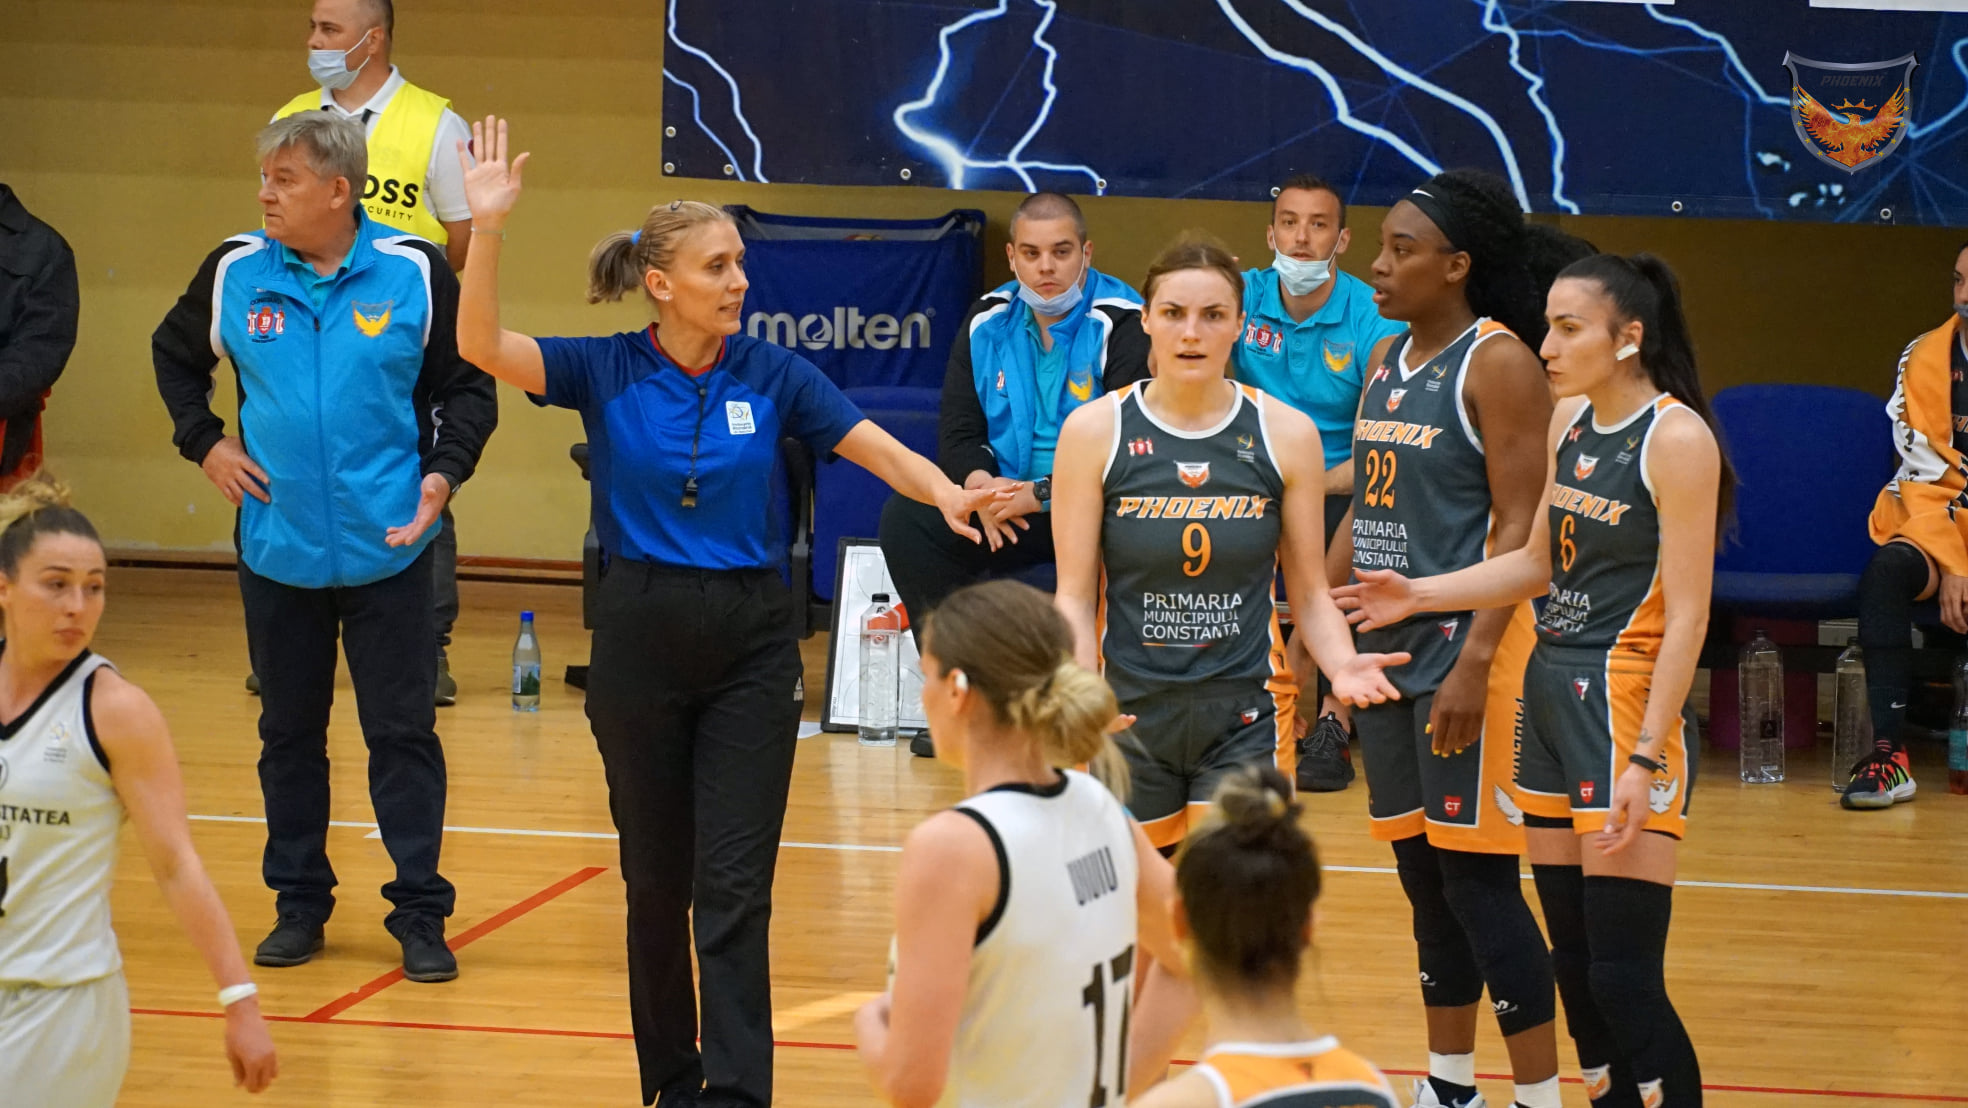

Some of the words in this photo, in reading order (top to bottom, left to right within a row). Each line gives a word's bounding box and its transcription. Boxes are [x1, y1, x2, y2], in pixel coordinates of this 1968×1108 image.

[363, 174, 419, 208] OSS
[367, 206, 413, 221] CURITY
[747, 307, 931, 350] molten
[1355, 419, 1444, 449] HOENIX
[1364, 449, 1397, 509] 22
[1116, 495, 1272, 520] PHOENIX
[1182, 522, 1211, 577] 9
[1559, 514, 1577, 573] 6
[1143, 592, 1242, 610] PRIMARIA
[1142, 623, 1241, 640] CONSTANTA
[1580, 786, 1594, 797] CT
[1444, 801, 1461, 811] CT
